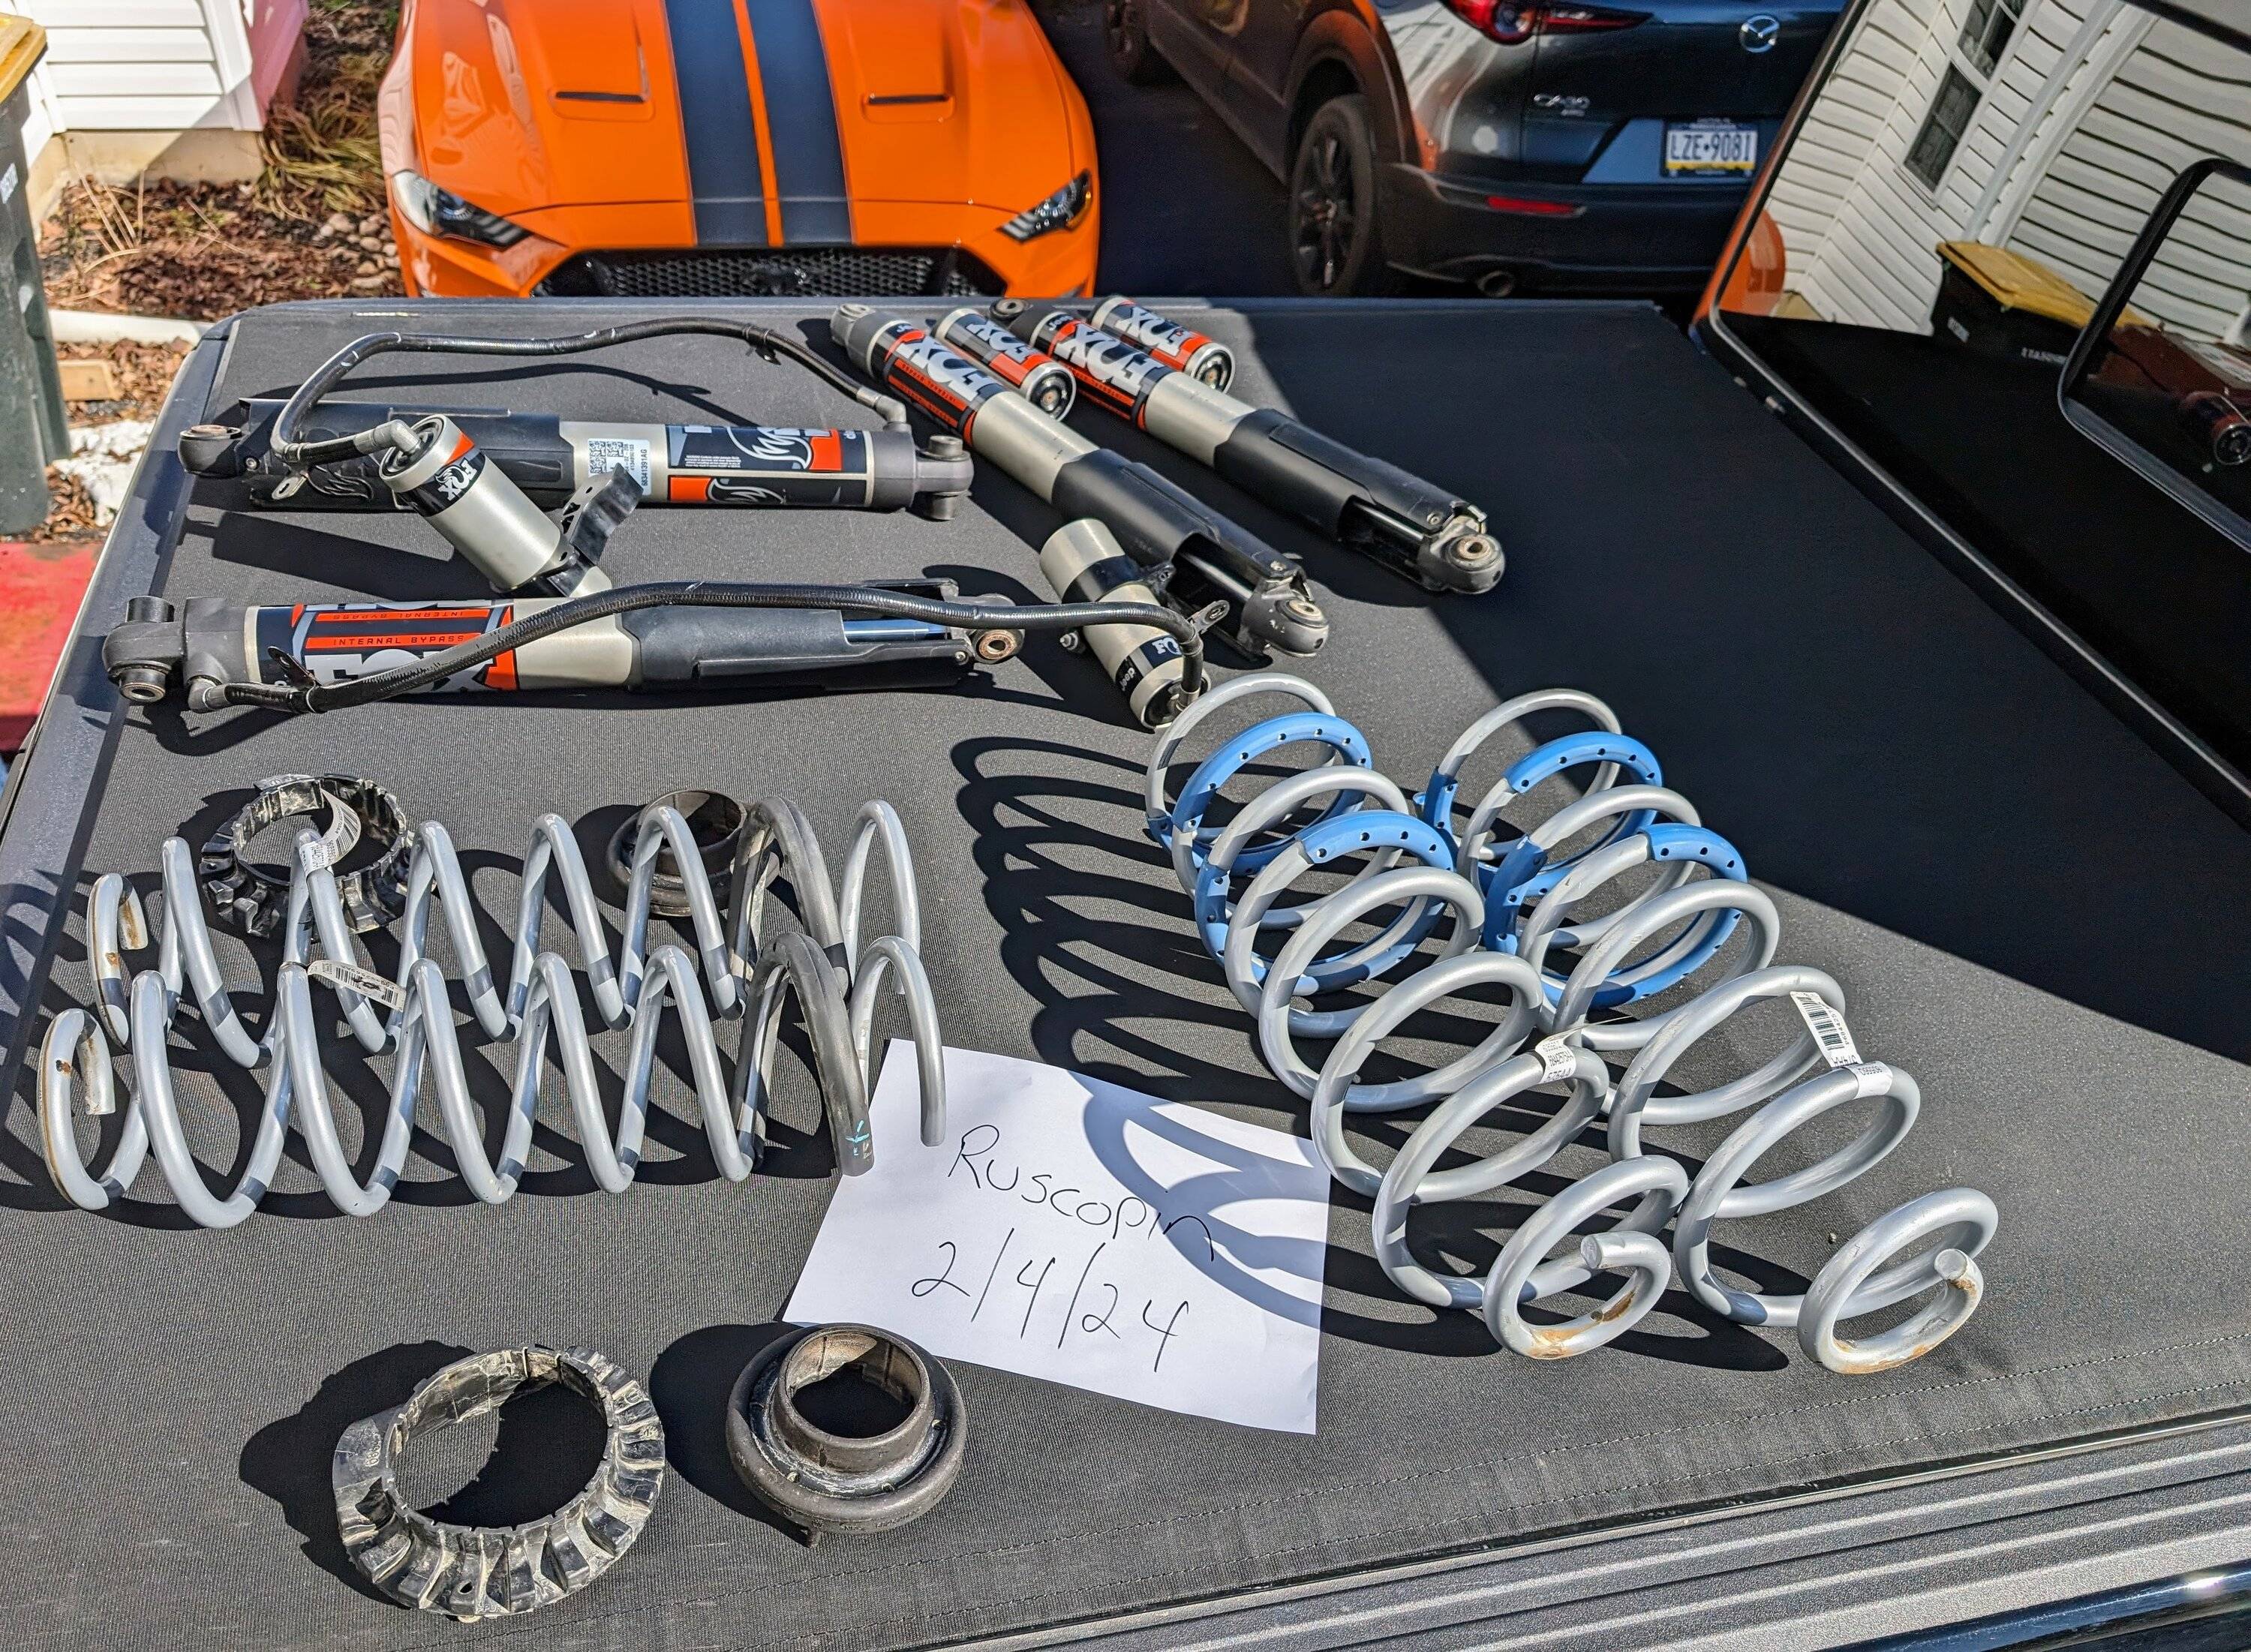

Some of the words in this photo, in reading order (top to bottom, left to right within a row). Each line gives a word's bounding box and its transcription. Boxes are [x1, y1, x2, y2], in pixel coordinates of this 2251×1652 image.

[966, 319, 1035, 364] FOX
[1115, 306, 1193, 356] FOX
[895, 335, 1003, 401] FOX
[1054, 323, 1165, 395] FOX
[435, 458, 477, 501] FOX
[333, 612, 388, 620] BYPASS
[333, 638, 401, 646] INTERNAL
[410, 635, 464, 643] BYPASS
[1152, 637, 1183, 655] FO
[911, 1227, 1189, 1373] 2/4/24
